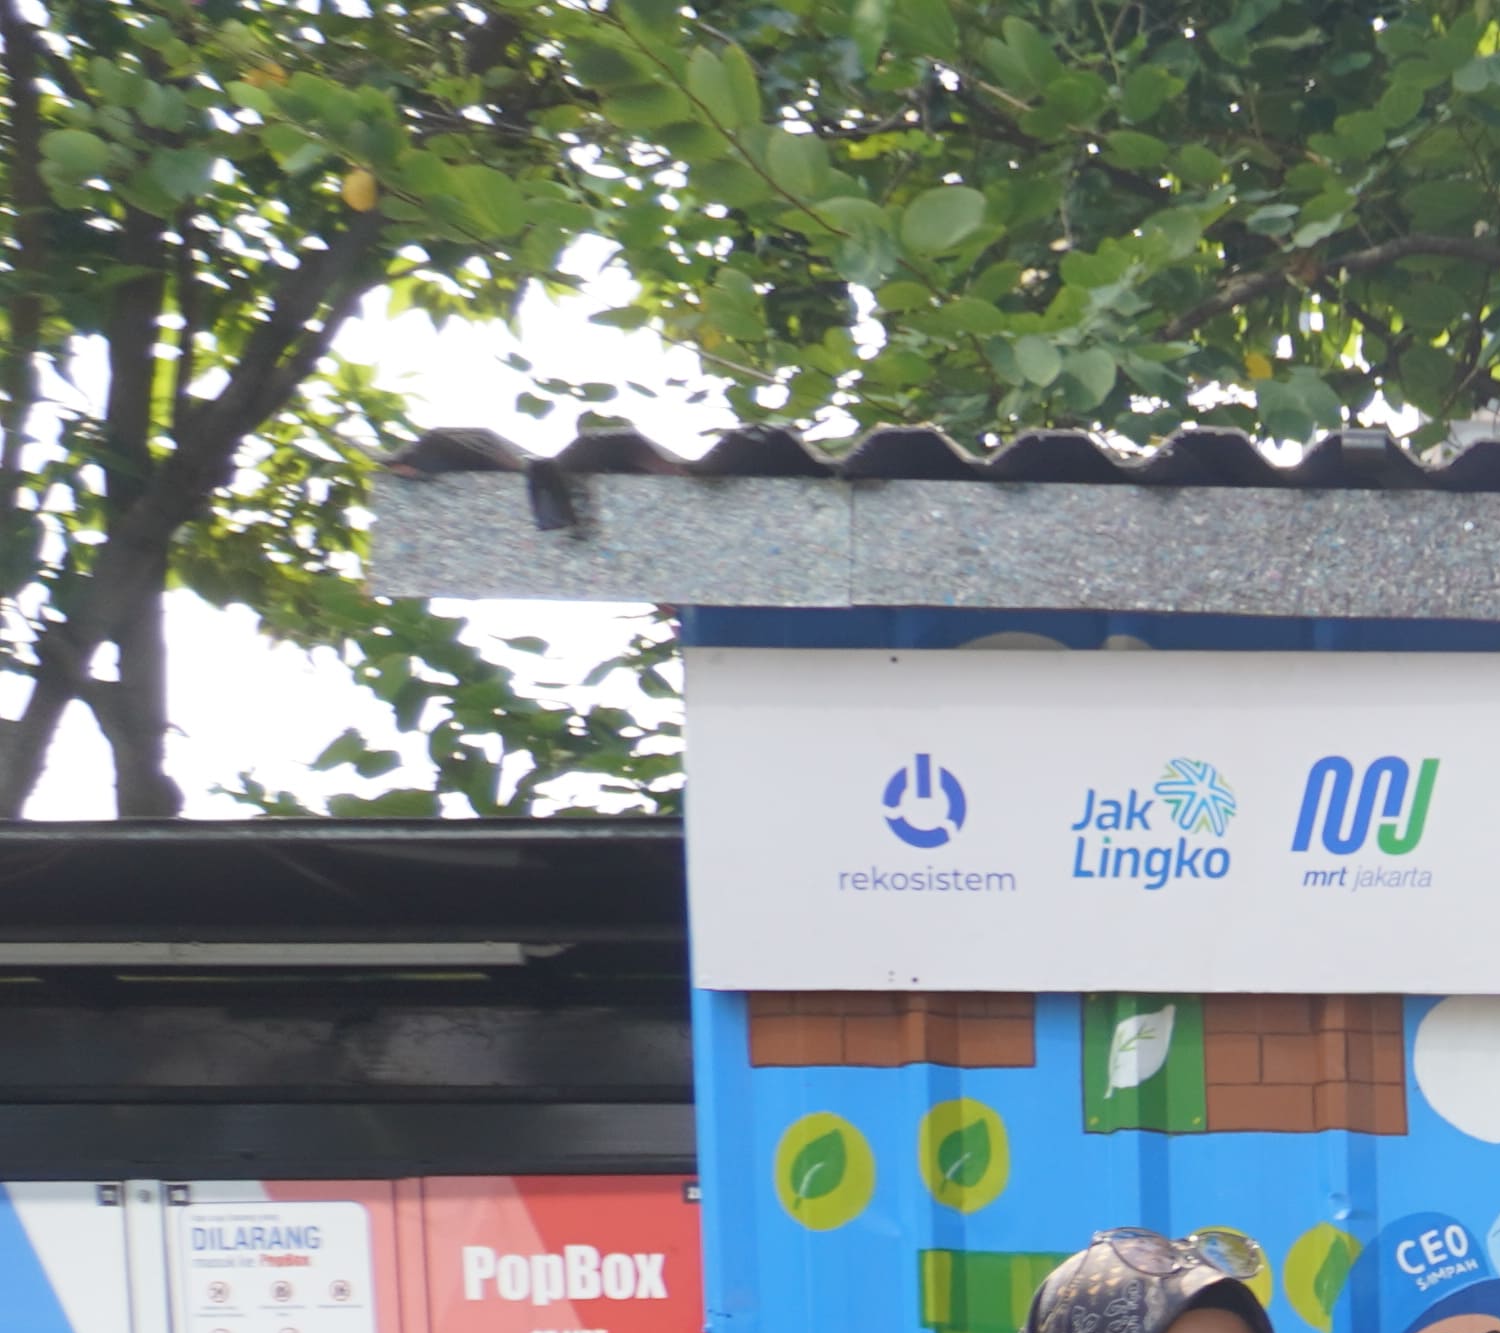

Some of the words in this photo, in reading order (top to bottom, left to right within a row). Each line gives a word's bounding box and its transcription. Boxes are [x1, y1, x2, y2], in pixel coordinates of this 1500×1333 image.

[1071, 787, 1150, 833] Jak
[839, 867, 1015, 893] rekosistem
[1071, 834, 1230, 889] Lingko
[1303, 868, 1347, 888] mrt
[1351, 867, 1432, 891] jakarta
[191, 1226, 321, 1251] DILARANG
[1396, 1225, 1468, 1274] CEO
[462, 1244, 668, 1306] PopBox
